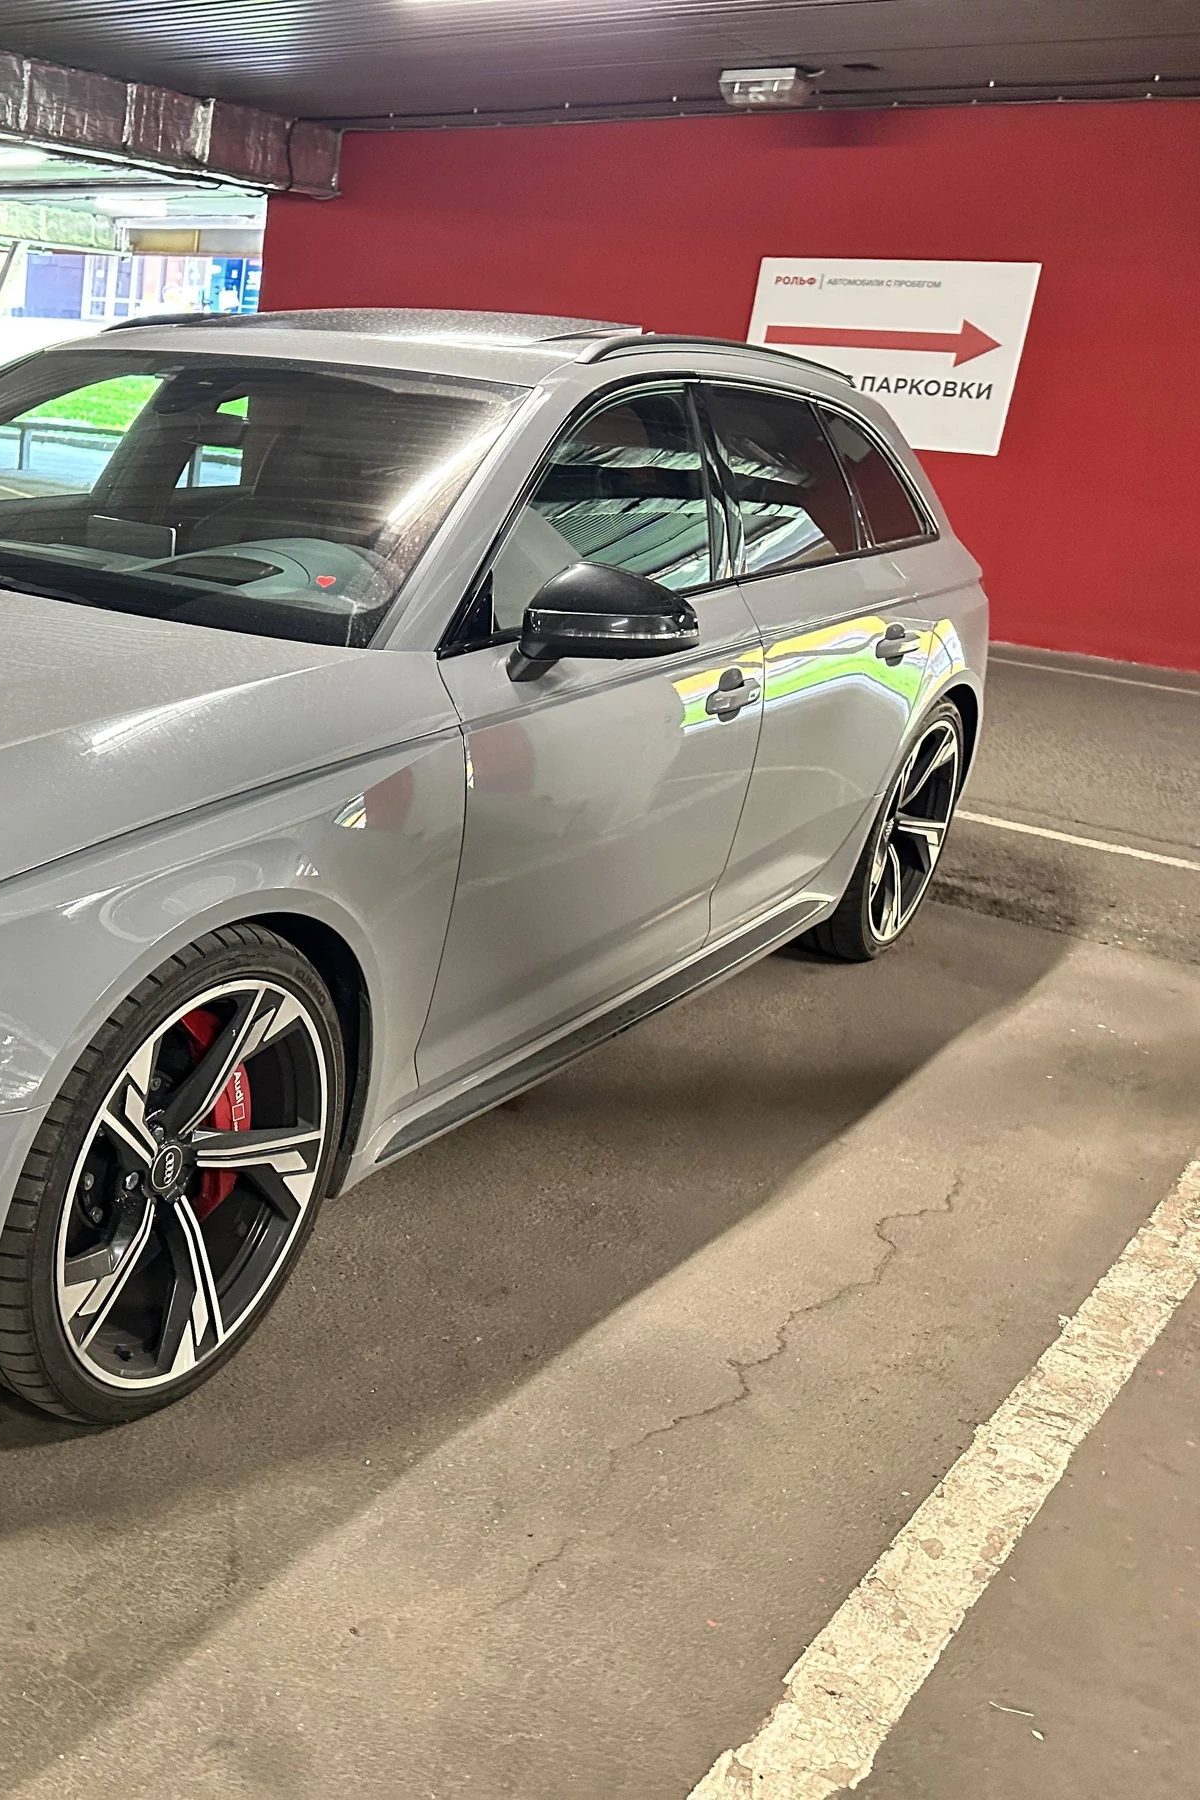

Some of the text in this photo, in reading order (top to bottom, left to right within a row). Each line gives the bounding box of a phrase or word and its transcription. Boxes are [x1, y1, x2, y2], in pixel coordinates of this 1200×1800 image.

[774, 275, 942, 289] РОЛЬФ АВТОМОБИЛИ С ПРОБЕГОМ
[860, 375, 994, 401] ПАРКОВКИ
[233, 1071, 245, 1105] Audi
